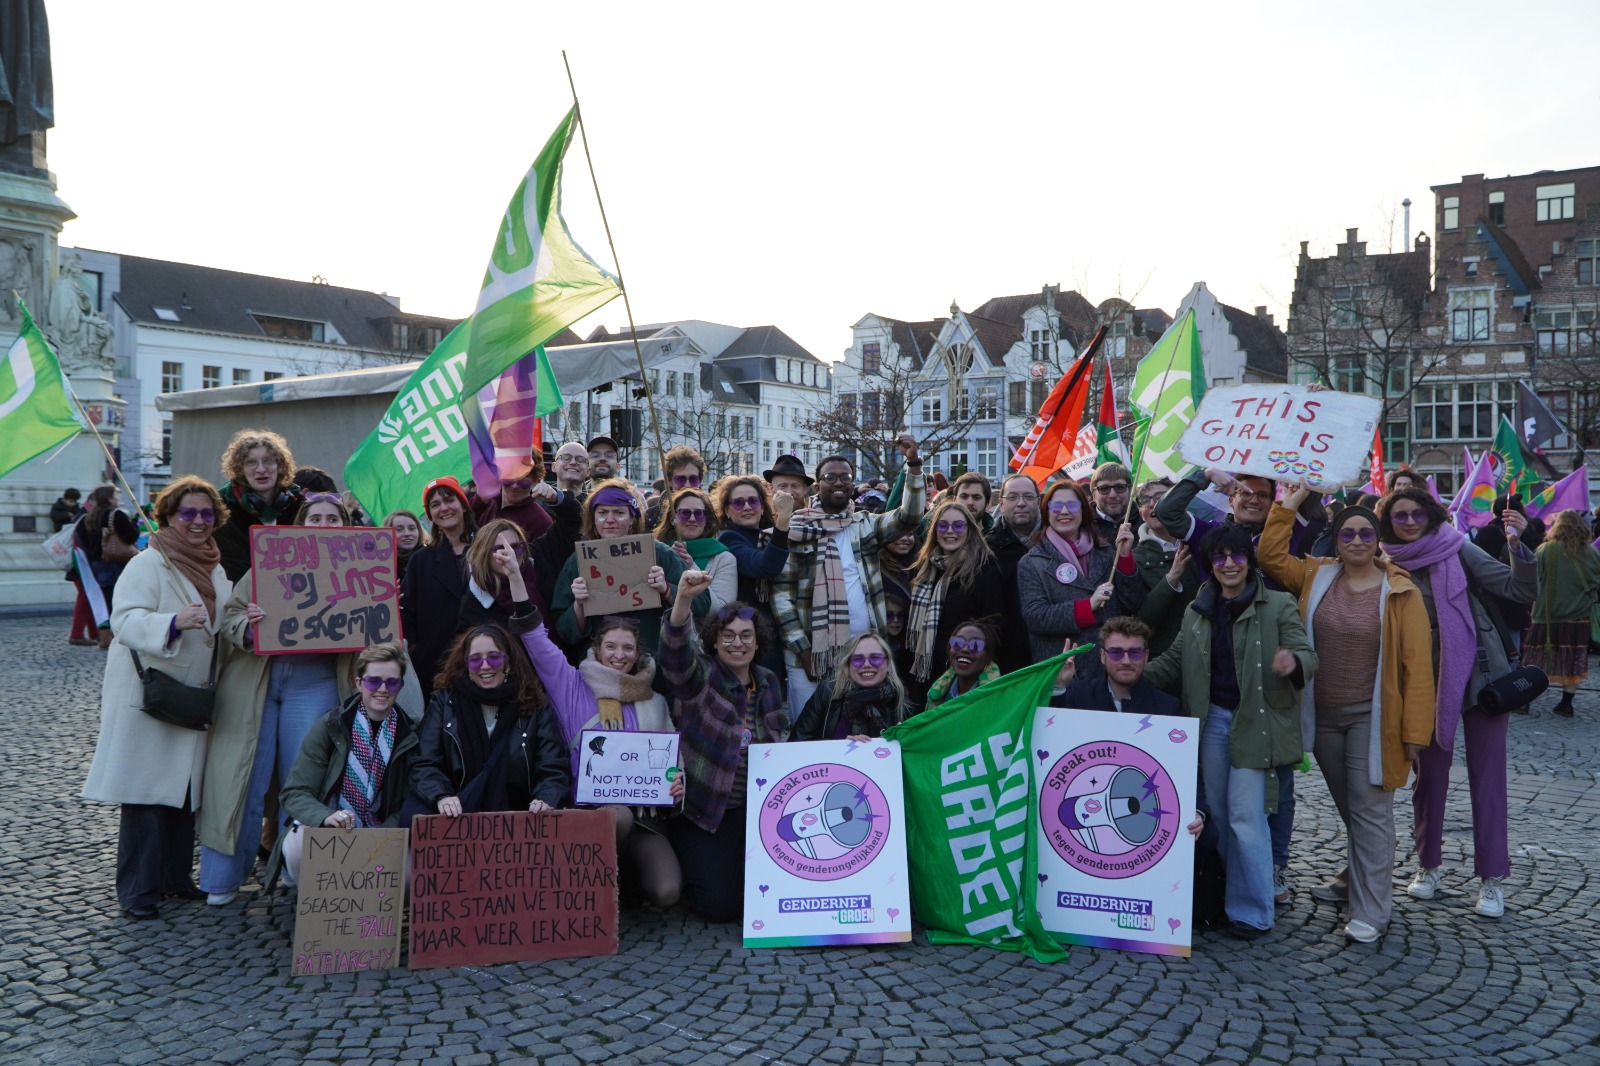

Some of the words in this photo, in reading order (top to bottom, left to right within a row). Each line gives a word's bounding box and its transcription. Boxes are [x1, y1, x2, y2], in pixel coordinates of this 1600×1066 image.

[1232, 397, 1321, 423] THIS
[1201, 419, 1270, 440] GIRL
[1299, 431, 1334, 453] IS
[1205, 445, 1252, 466] ON
[609, 541, 642, 557] BEN
[325, 565, 395, 602] SLUT
[590, 565, 643, 607] BOOS
[620, 753, 639, 761] OR
[1049, 753, 1087, 790] Speak
[1088, 746, 1117, 759] out!
[593, 775, 622, 784] NOT
[625, 775, 662, 785] YOUR
[767, 776, 802, 810] Speak
[802, 767, 829, 781] out!
[593, 789, 659, 798] BUSINESS
[415, 817, 438, 841] WE
[442, 815, 515, 840] ZOUDEN
[524, 814, 563, 839] NIET
[309, 835, 357, 864] MY
[414, 843, 476, 869] MOETEN
[481, 842, 555, 866] VECHTEN
[561, 842, 606, 866] VOOR
[772, 843, 795, 866] tegen
[796, 830, 883, 874] genderongelijkheid
[1053, 830, 1076, 854] tegen
[1077, 829, 1171, 871] genderongelijkheid
[414, 870, 467, 898] ONZE
[479, 867, 561, 892] RECHTEN
[569, 867, 615, 888] MAAR
[300, 897, 364, 915] SEASON
[412, 900, 456, 924] HIER
[460, 893, 515, 918] STAAN
[522, 891, 547, 911] WE
[553, 890, 595, 911] TOCH
[781, 897, 869, 911] GENDERNET
[839, 908, 875, 923] GROEN
[1060, 894, 1150, 914] GENDERNET
[323, 918, 354, 936] THE
[357, 915, 397, 939] FALL
[1119, 912, 1155, 930] GROEN
[303, 940, 320, 952] OF
[412, 926, 466, 954] MAAR
[474, 921, 523, 945] WEER
[532, 916, 607, 944] LEKKER
